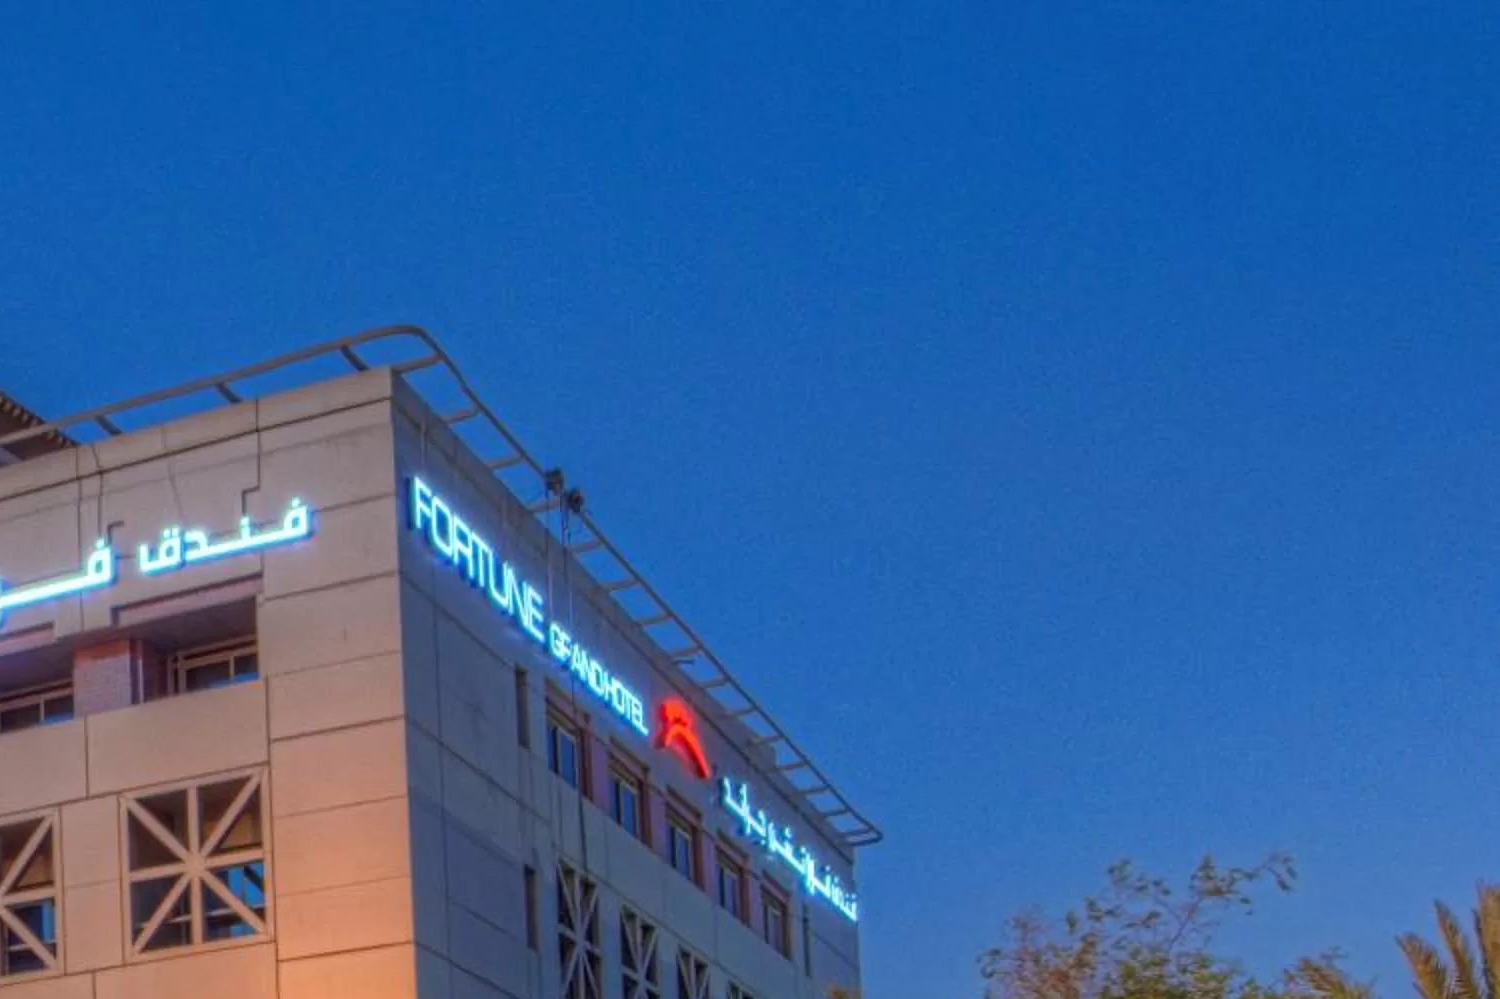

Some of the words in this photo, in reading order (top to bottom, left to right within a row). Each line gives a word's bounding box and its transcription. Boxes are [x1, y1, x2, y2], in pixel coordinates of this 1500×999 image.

[137, 496, 312, 575] فندق
[409, 476, 545, 643] FORTUNE
[604, 672, 649, 736] HOTEL
